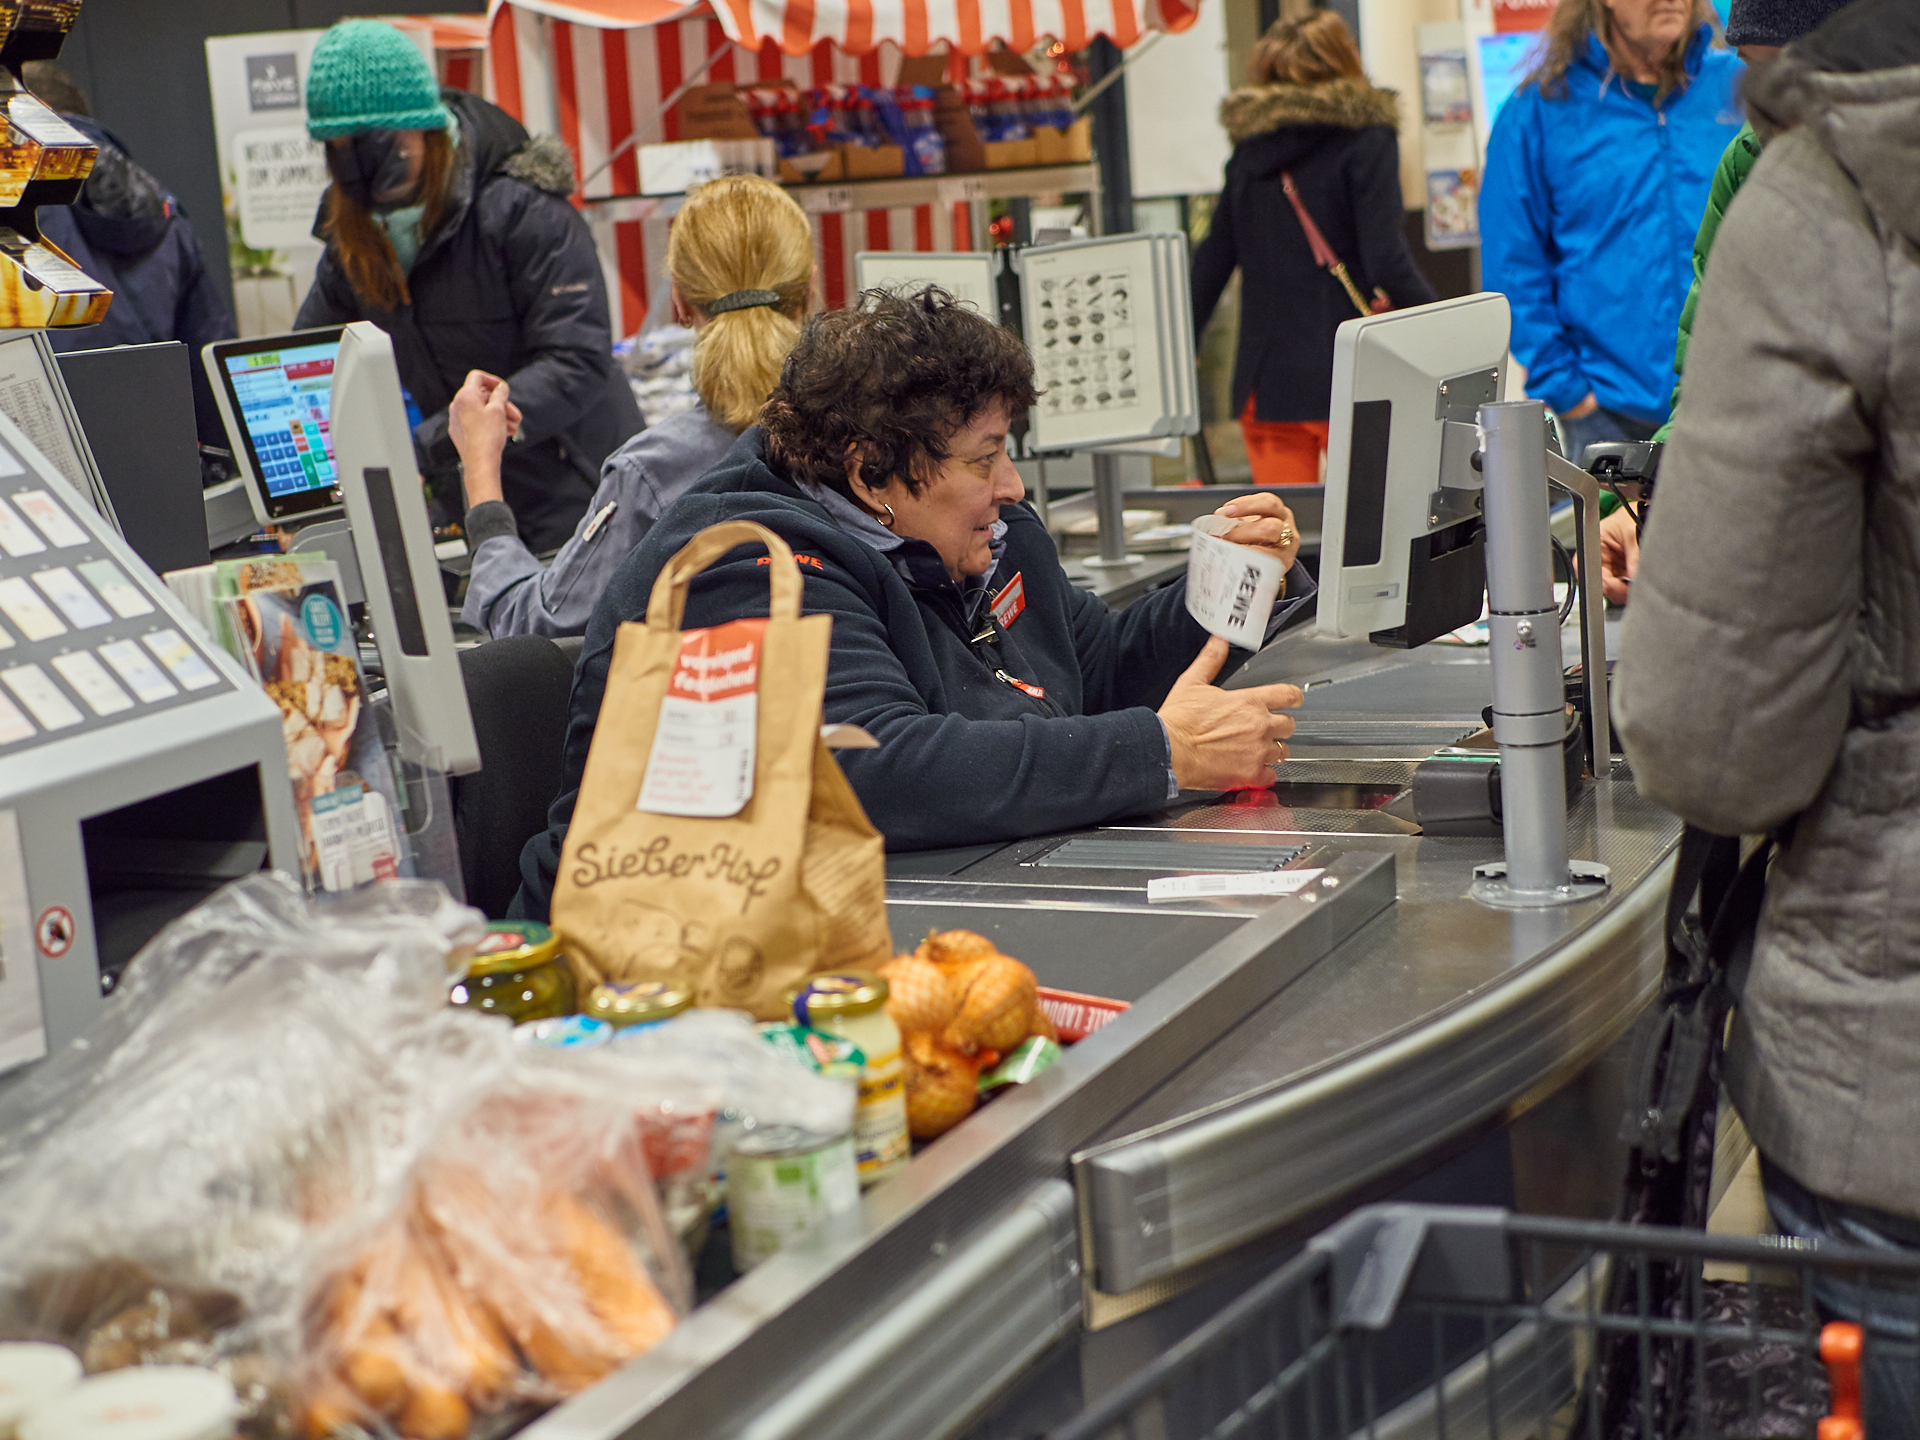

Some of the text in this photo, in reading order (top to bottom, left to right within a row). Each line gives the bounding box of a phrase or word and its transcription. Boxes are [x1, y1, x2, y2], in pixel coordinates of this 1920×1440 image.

[756, 553, 824, 571] RWE
[1227, 564, 1261, 629] REWE
[998, 600, 1019, 628] REWE
